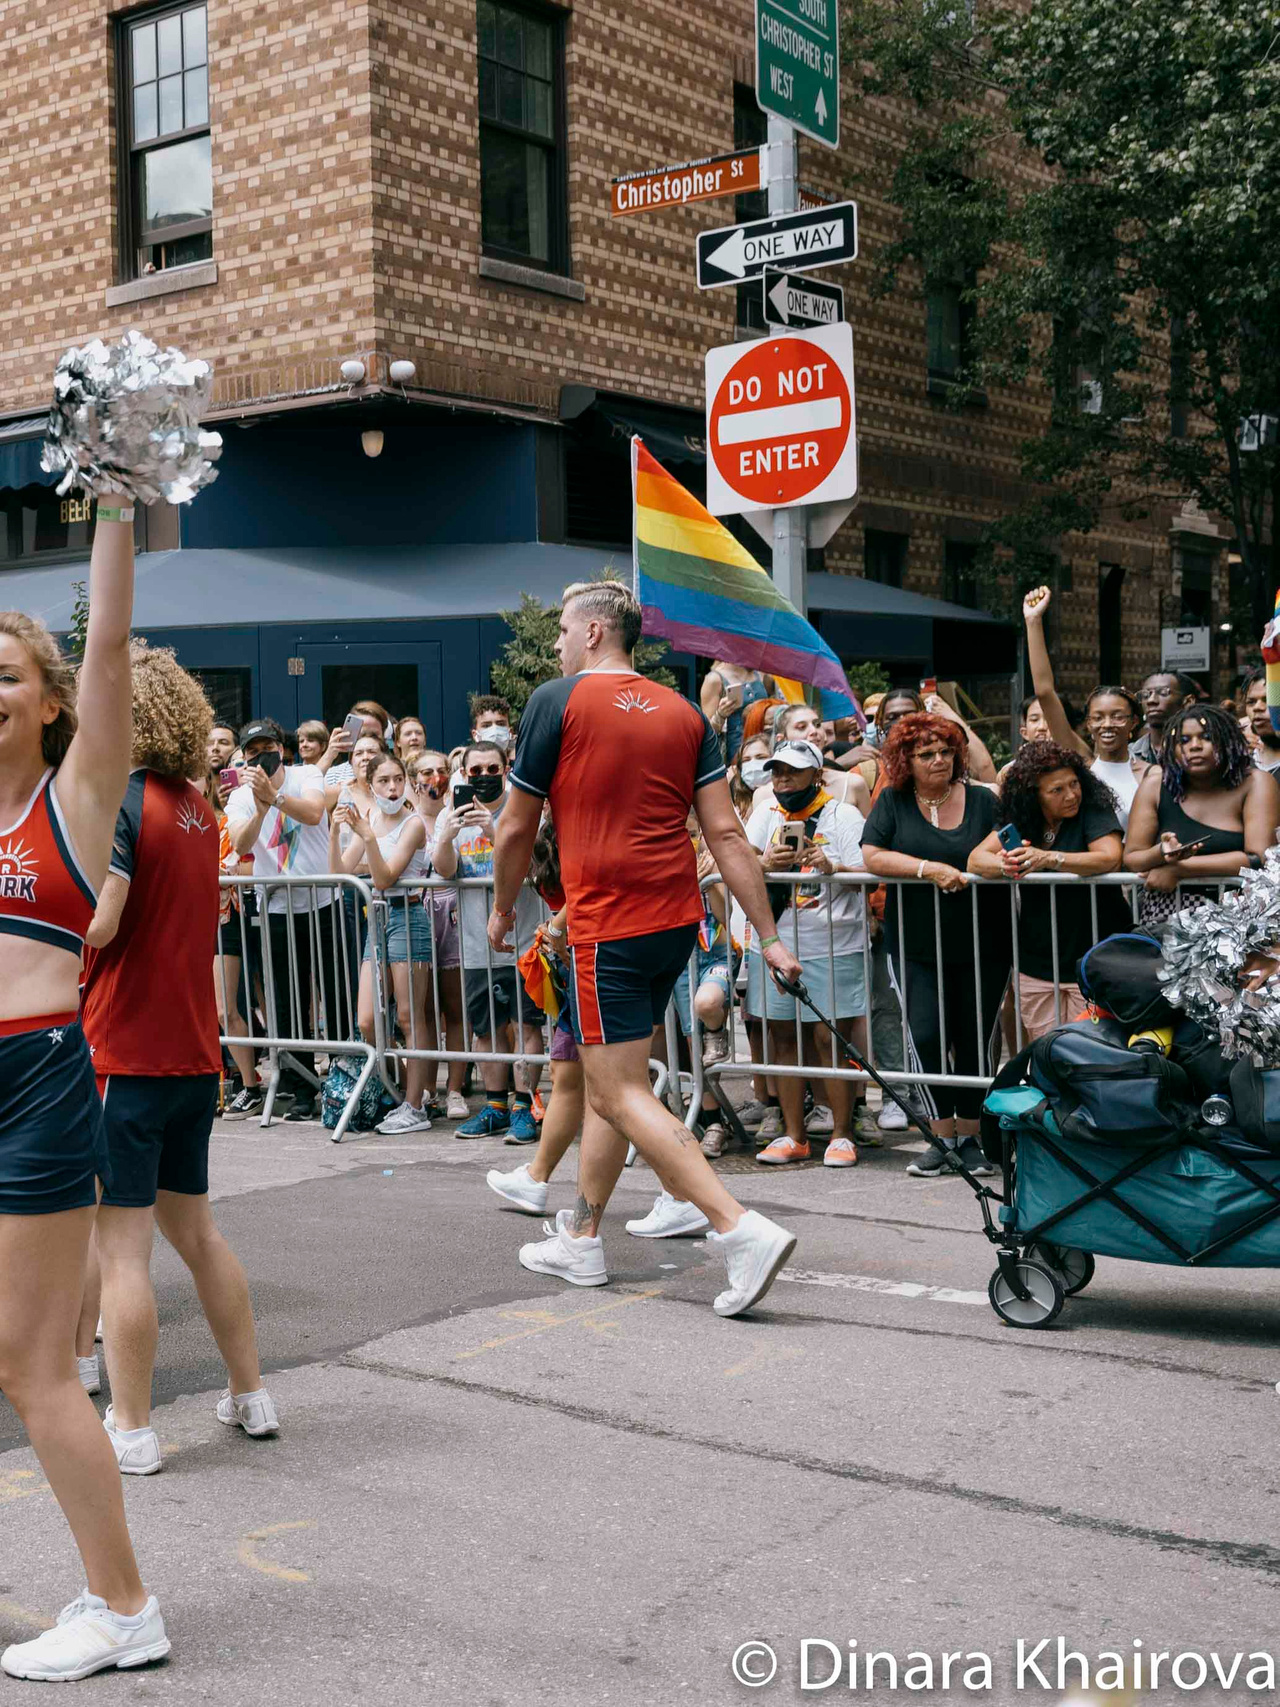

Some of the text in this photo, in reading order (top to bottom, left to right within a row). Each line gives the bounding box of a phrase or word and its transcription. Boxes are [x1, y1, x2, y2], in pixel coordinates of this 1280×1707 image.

[799, 0, 827, 27] SOUTH
[761, 12, 834, 80] CHRISTOPHER ST
[770, 63, 794, 102] WEST
[616, 168, 723, 210] Christopher
[730, 159, 744, 178] St
[744, 224, 837, 261] ONE WAY
[787, 290, 835, 321] ONE WAY
[729, 363, 828, 406] DO NOT
[740, 441, 820, 477] ENTER
[60, 497, 91, 524] BEER
